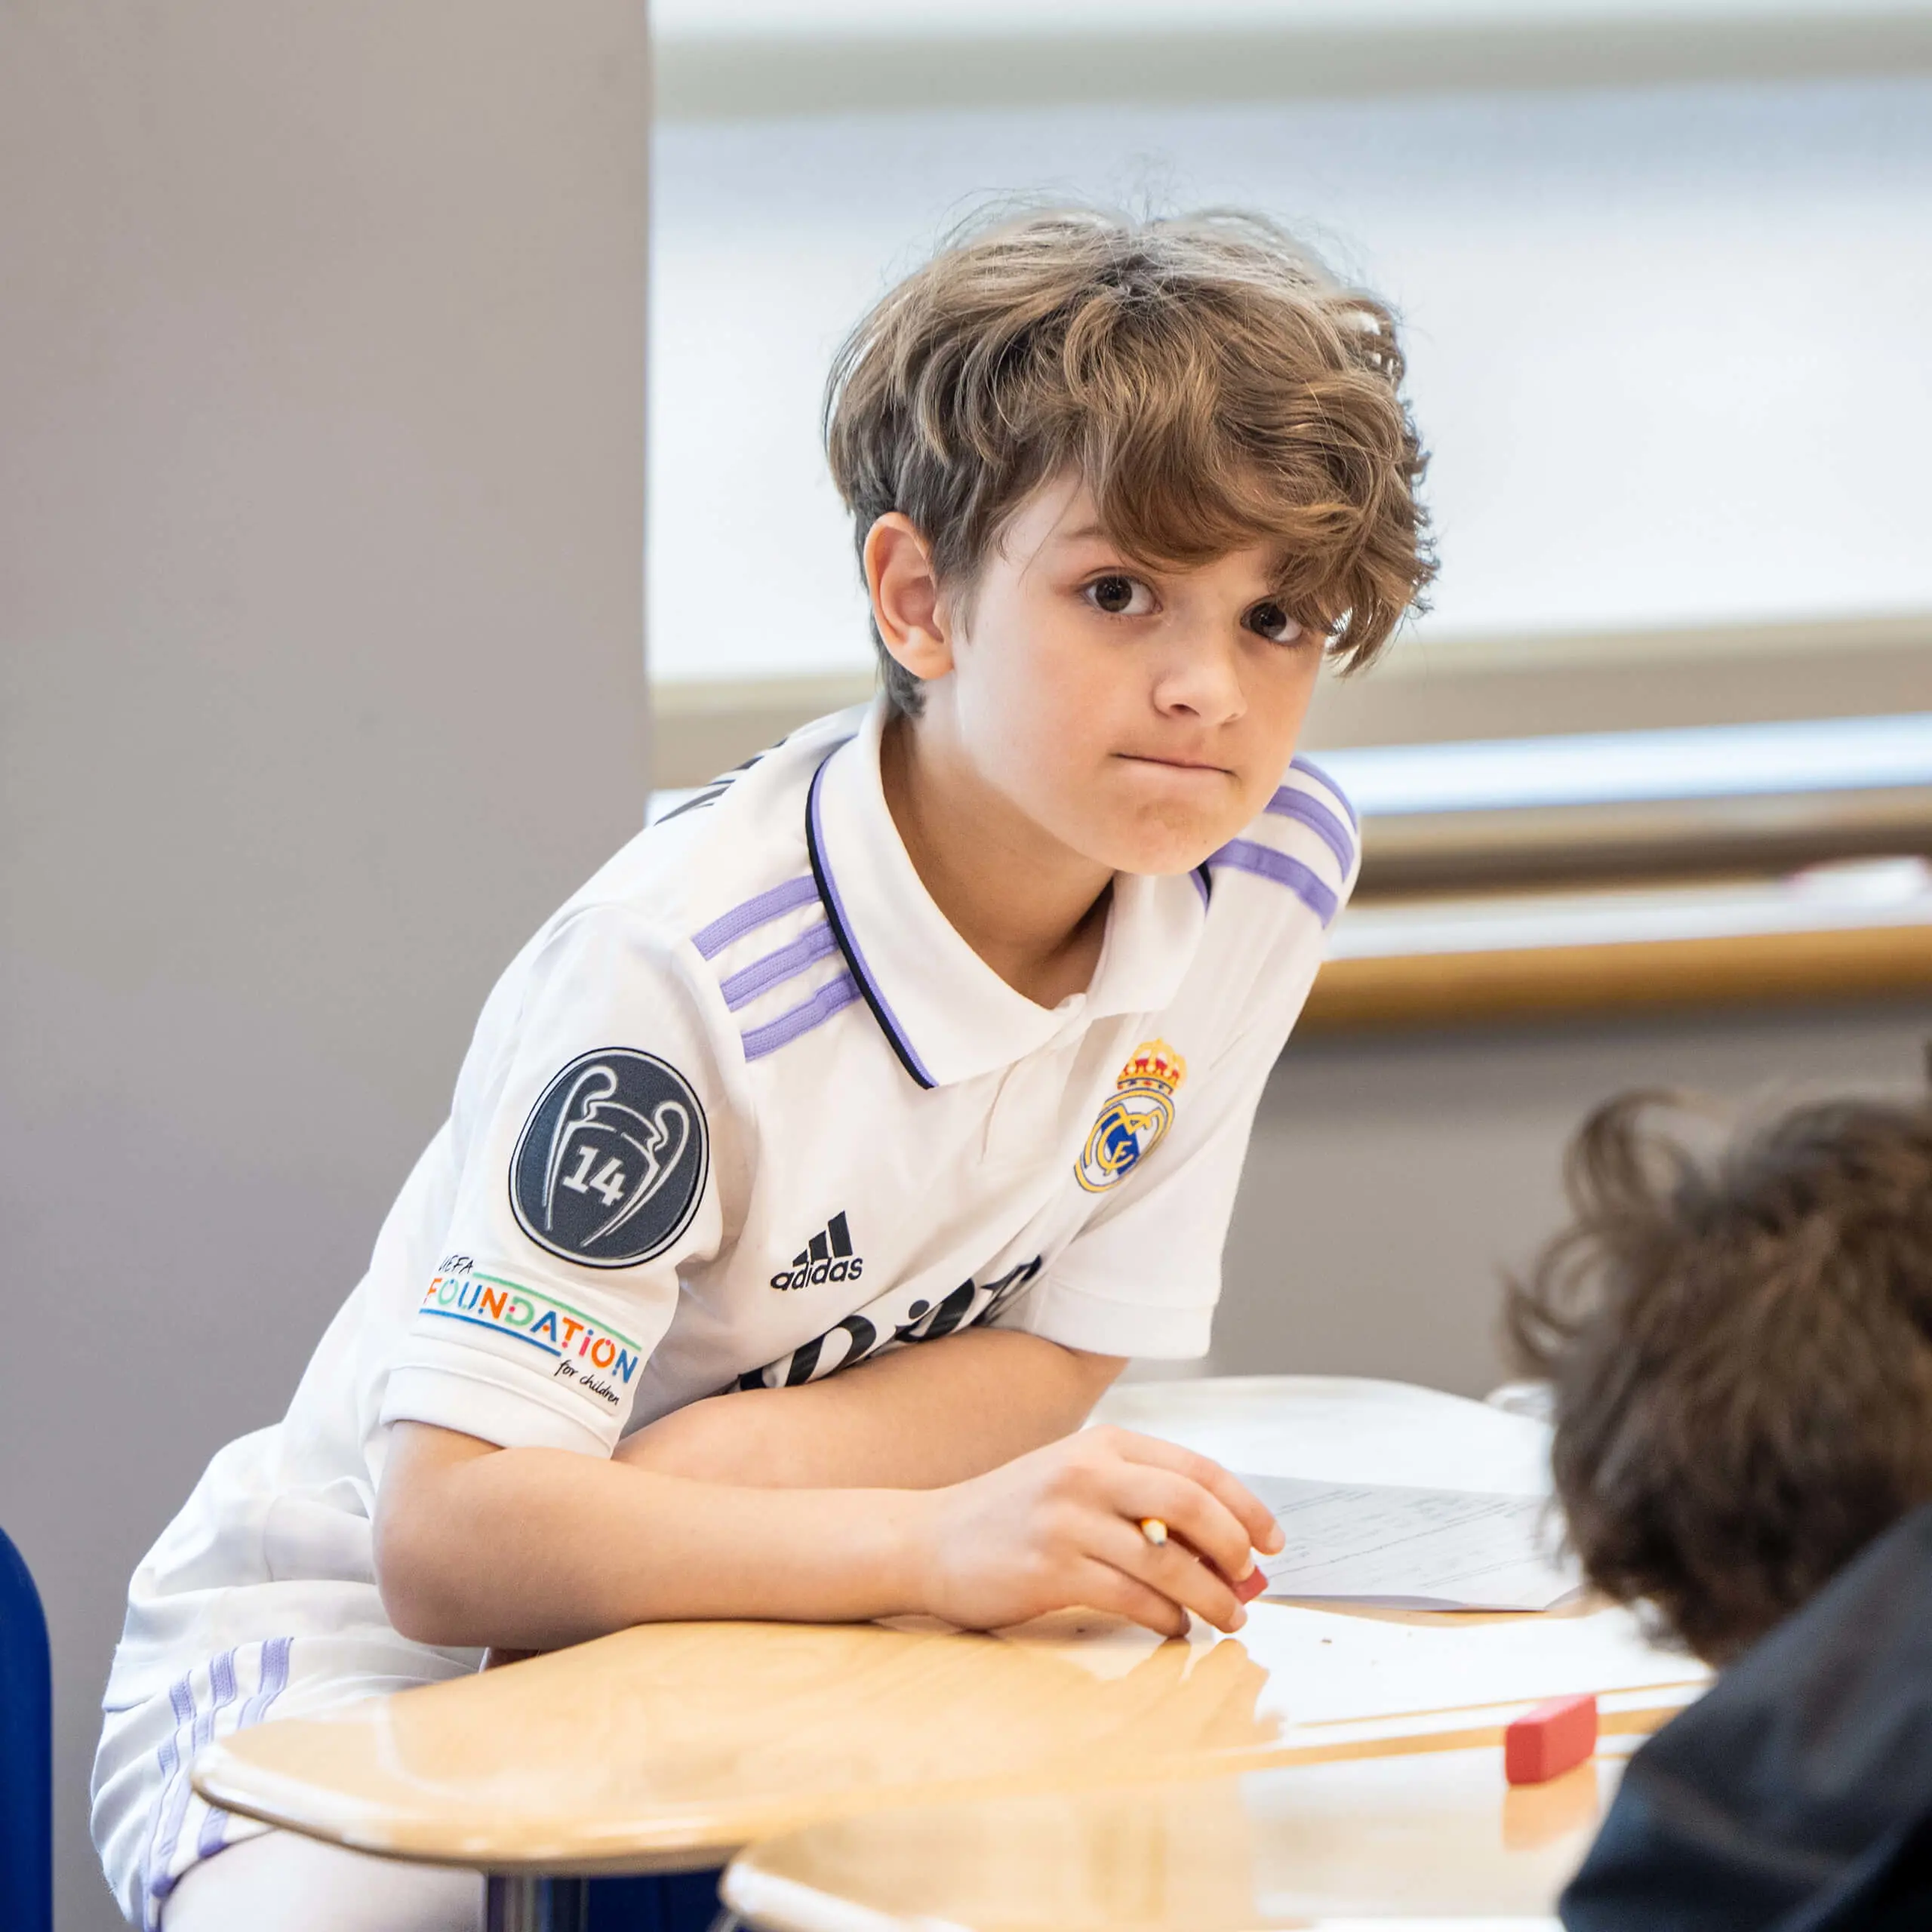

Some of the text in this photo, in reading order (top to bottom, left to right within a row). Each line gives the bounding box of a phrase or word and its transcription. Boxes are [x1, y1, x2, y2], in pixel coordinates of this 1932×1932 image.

[562, 1146, 626, 1206] 14
[438, 1254, 474, 1275] UEFA
[771, 1257, 863, 1291] adidas
[423, 1278, 638, 1383] FOUNDATION
[553, 1359, 620, 1406] for children
